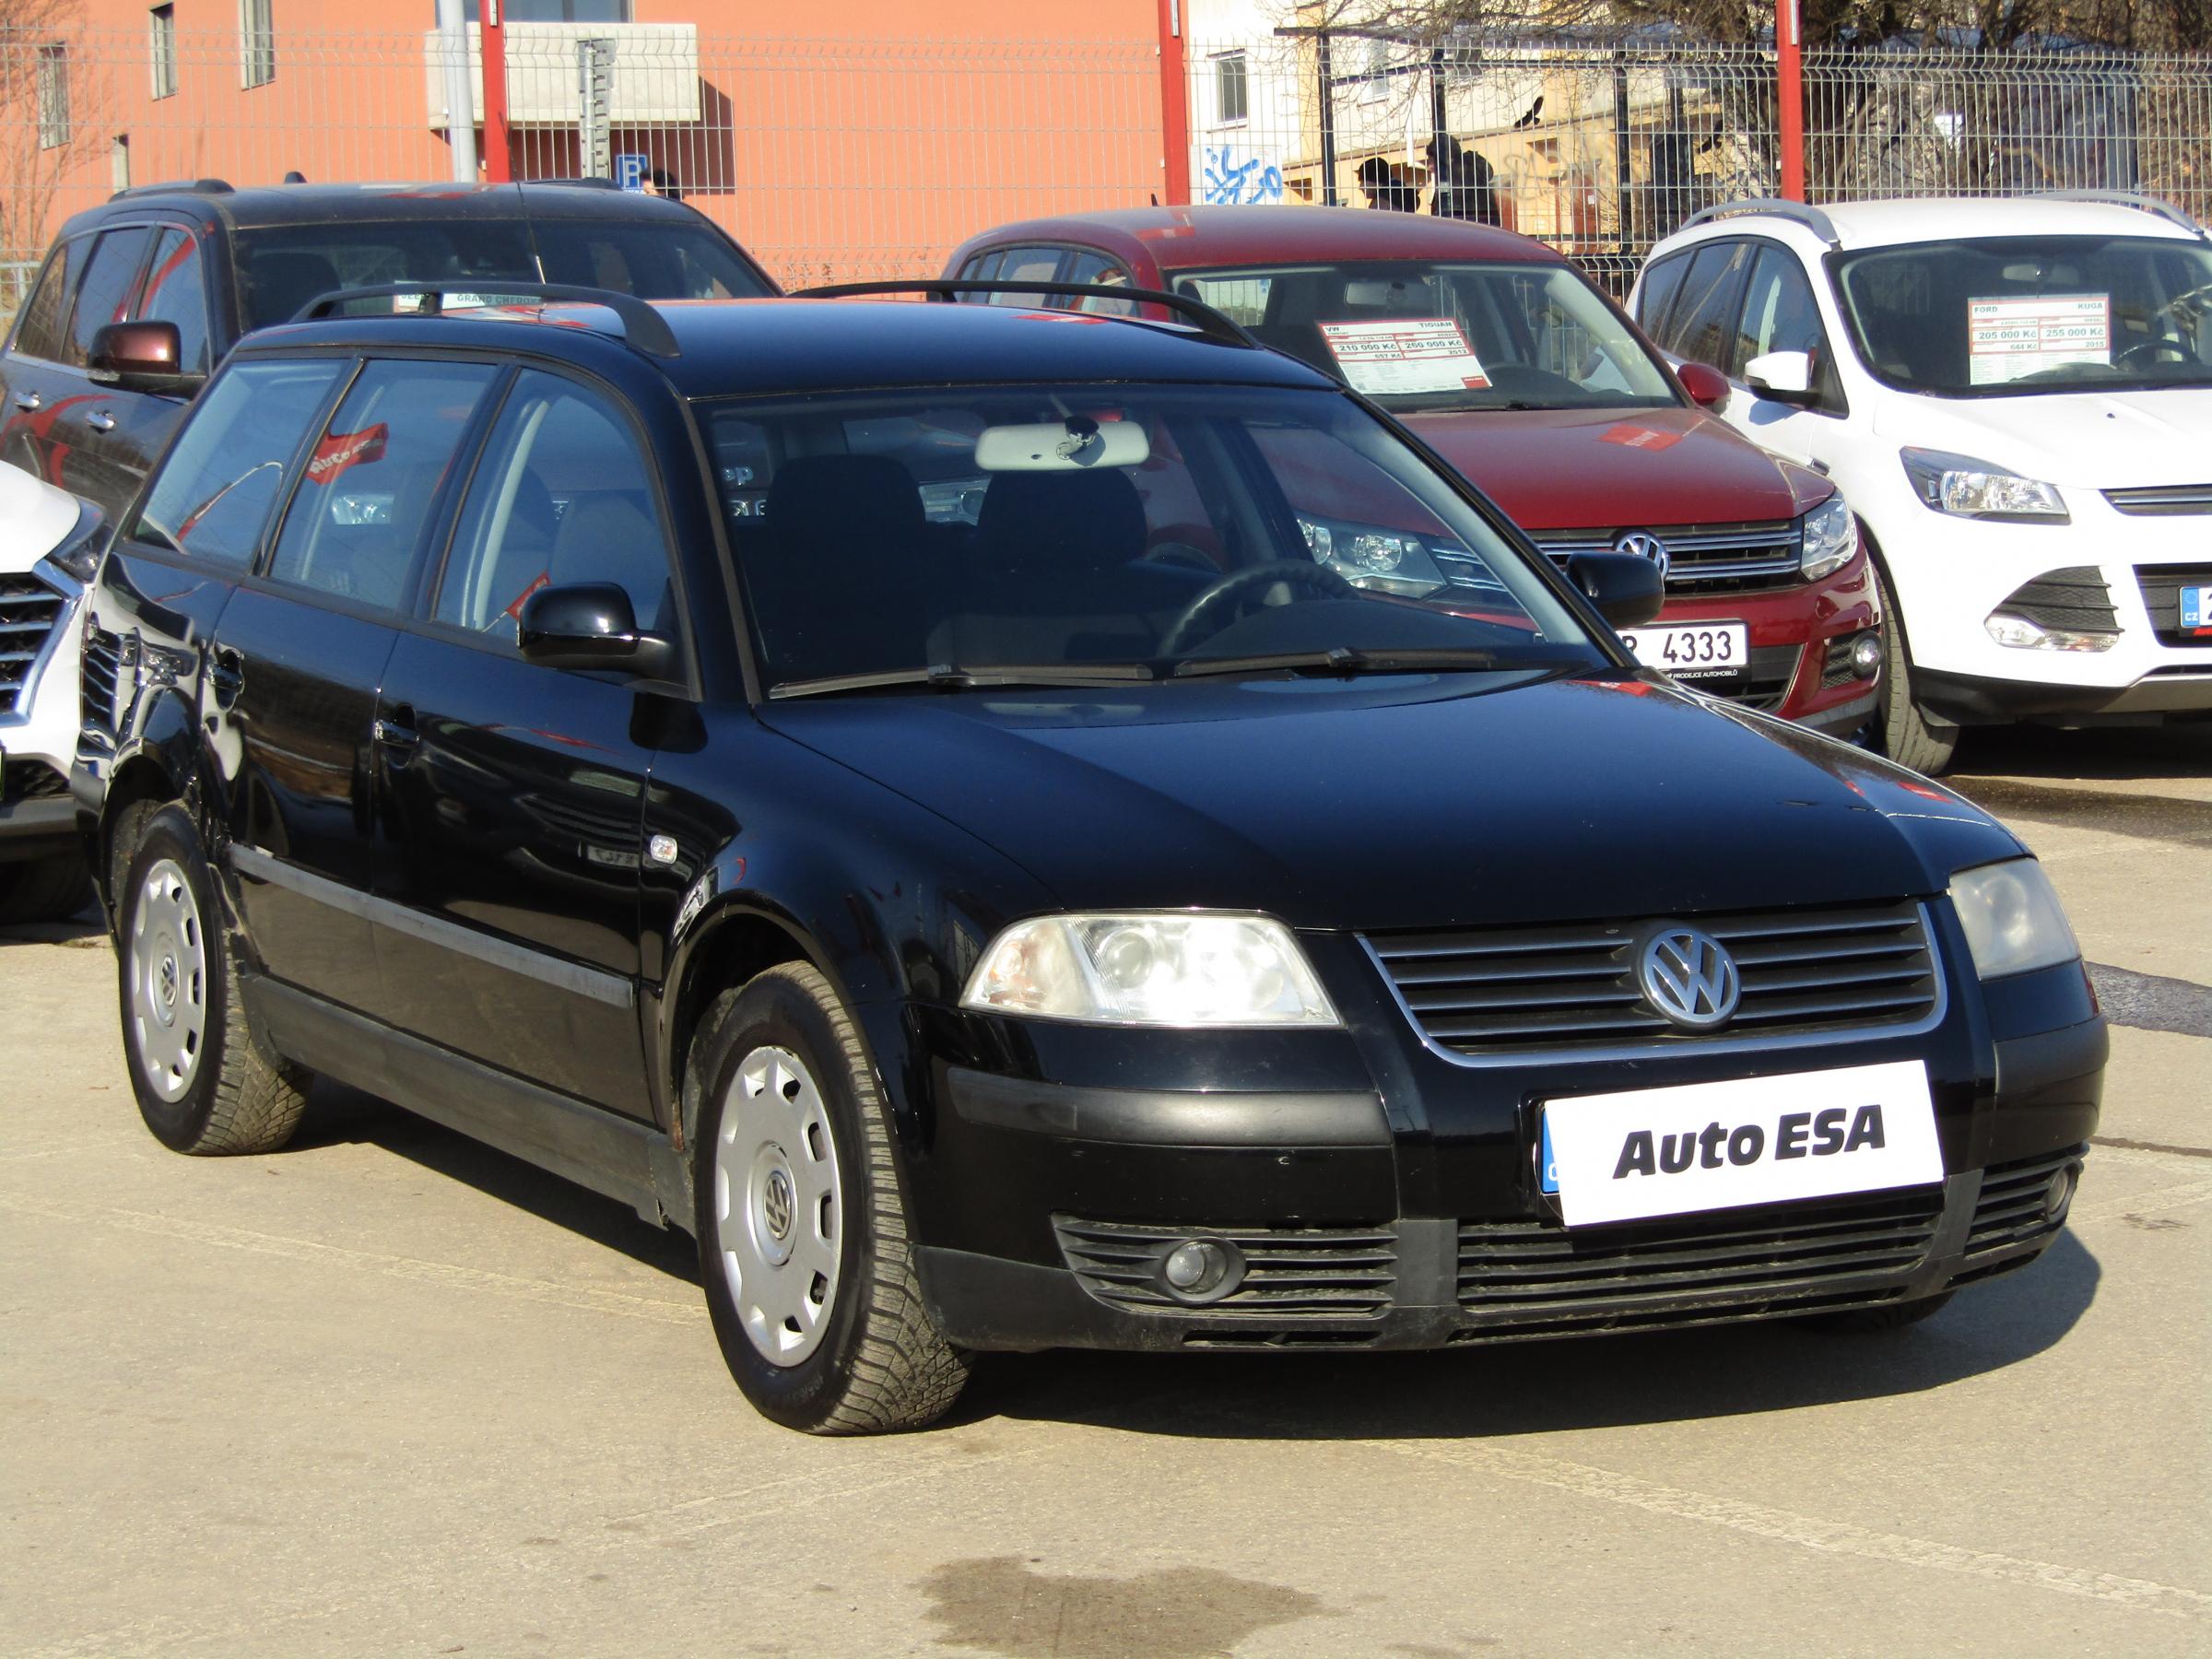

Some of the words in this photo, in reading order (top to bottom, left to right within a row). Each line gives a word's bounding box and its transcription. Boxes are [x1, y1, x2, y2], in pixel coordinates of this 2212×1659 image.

[456, 294, 493, 303] GRAND
[1979, 332, 1998, 340] 205
[2001, 331, 2019, 339] 000
[2023, 330, 2037, 338] Kč
[2089, 327, 2104, 335] Kč
[2184, 612, 2198, 621] CZ
[1663, 631, 1732, 663] 4333
[1673, 671, 1702, 679] PRODEJCE
[1702, 668, 1738, 678] AUTOMOBILŮ
[1613, 1122, 1765, 1179] Auto
[1774, 1104, 1886, 1160] ESA
